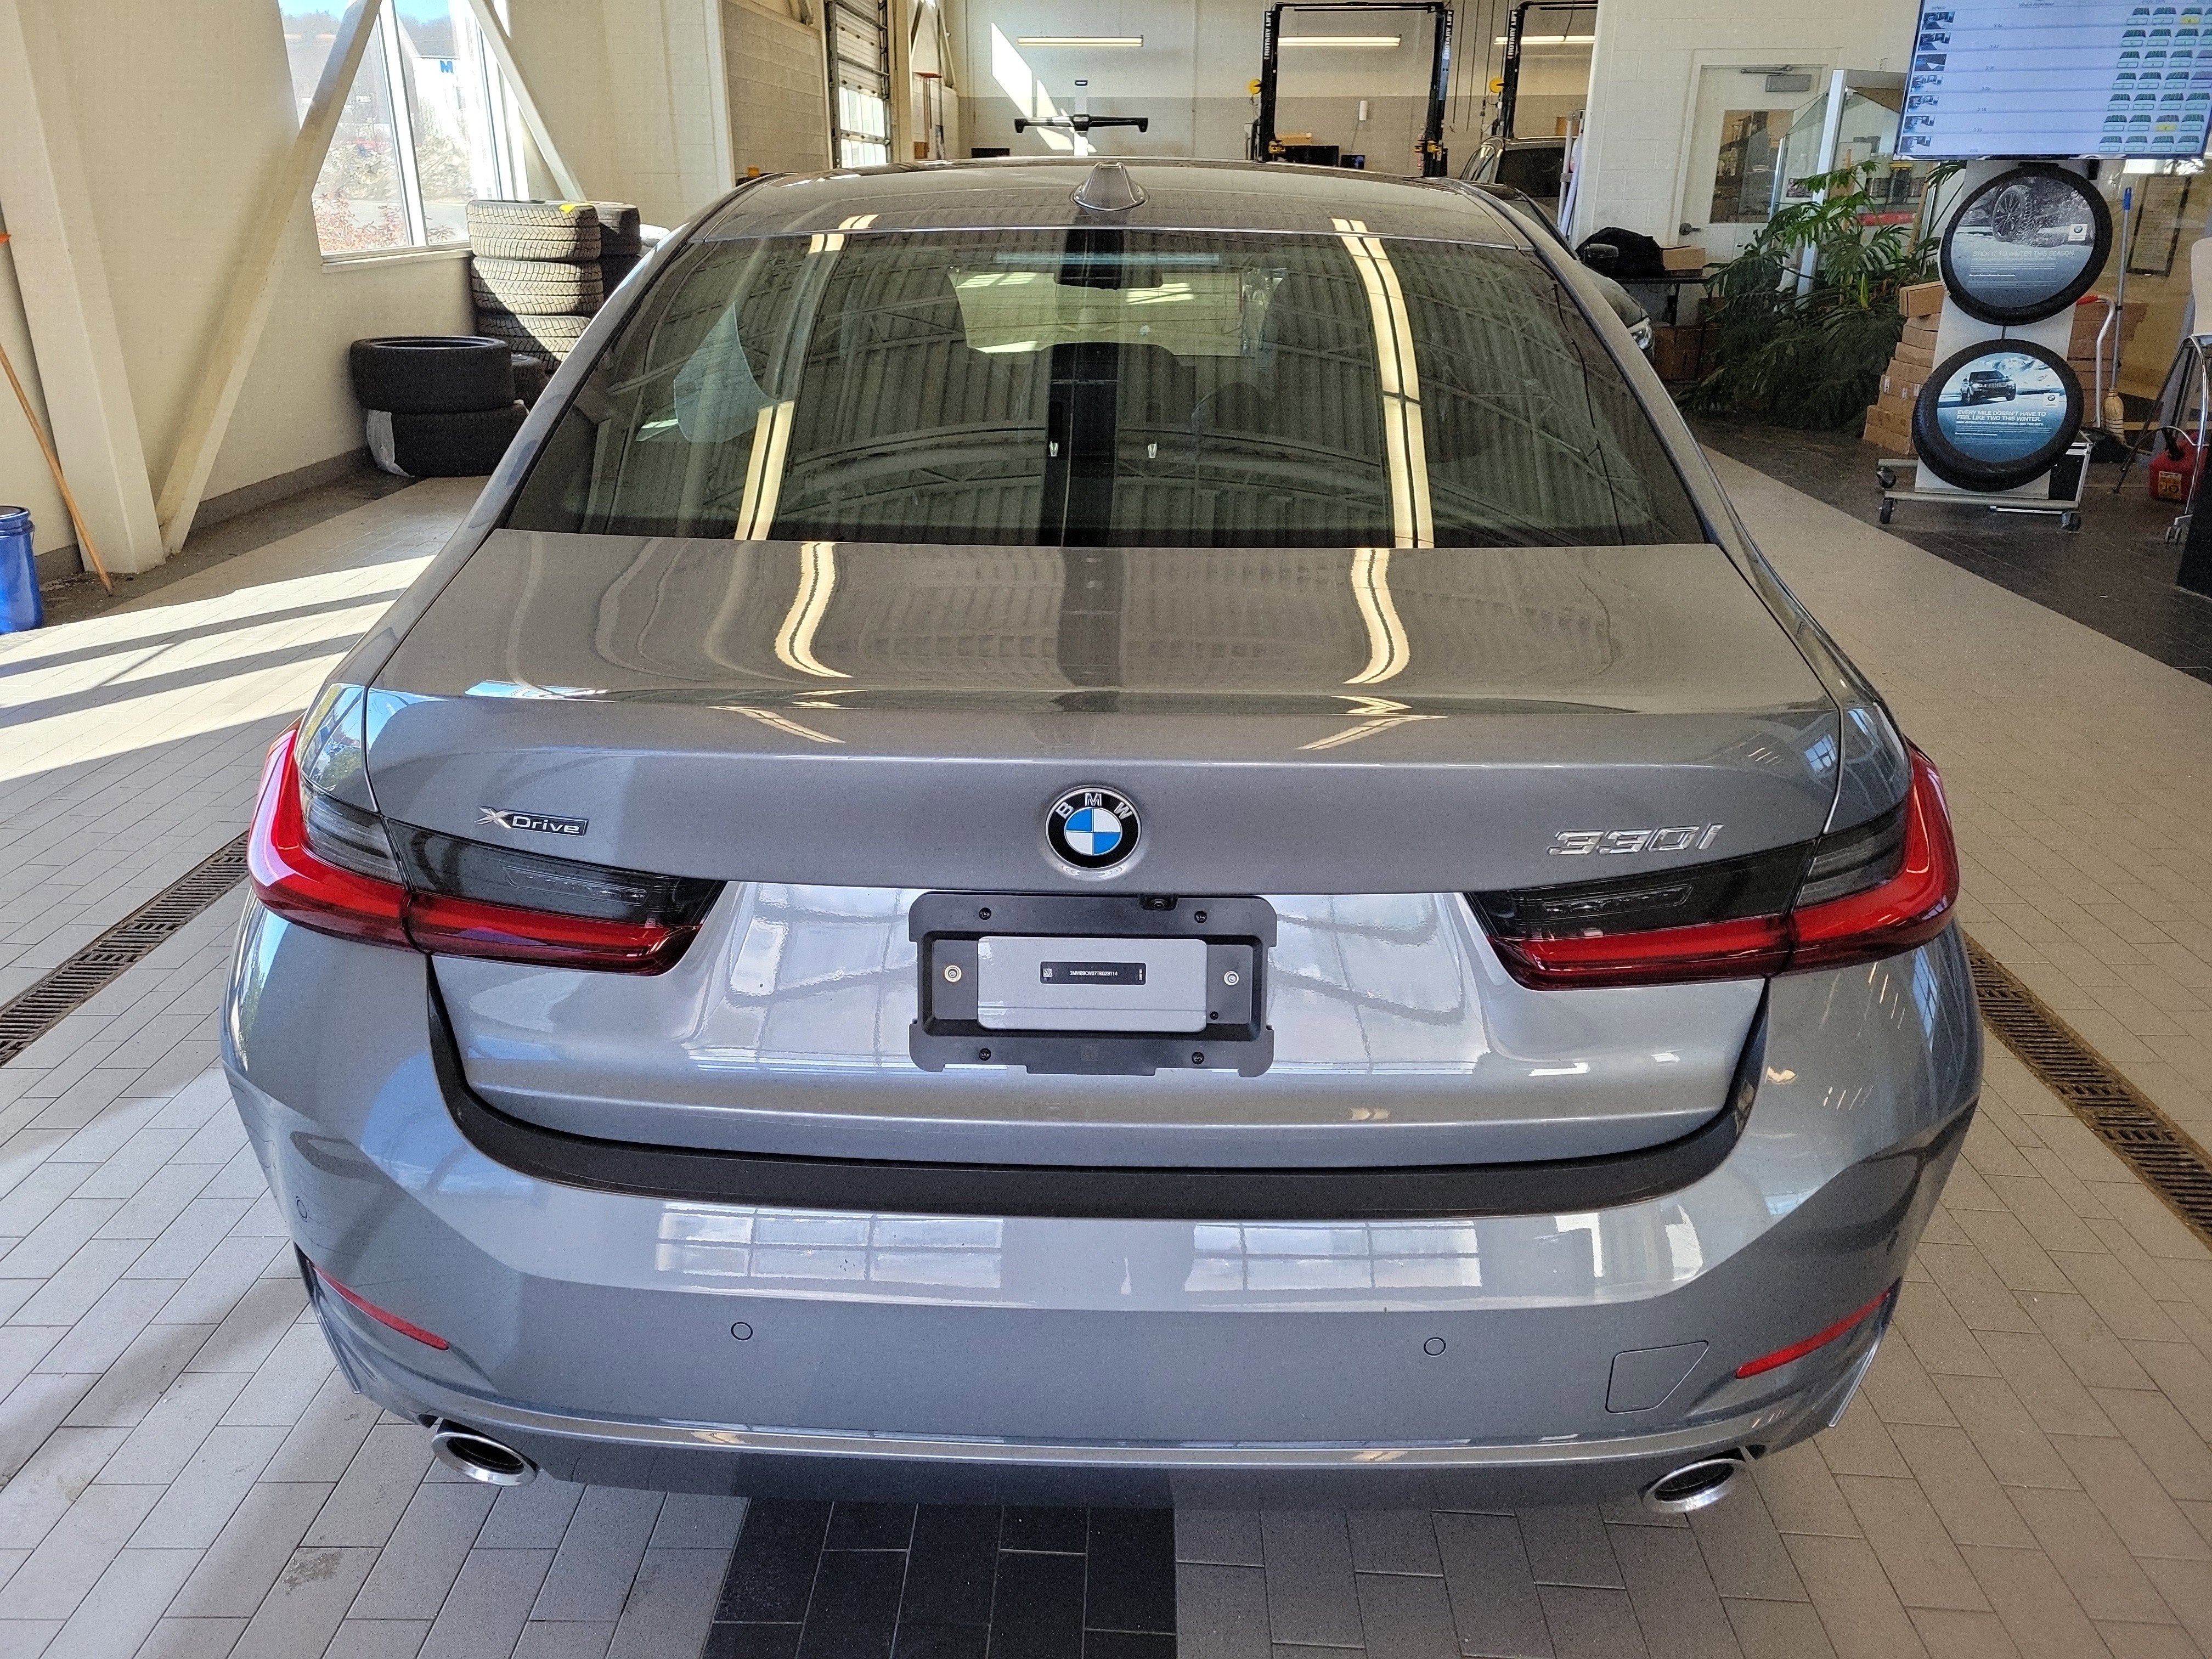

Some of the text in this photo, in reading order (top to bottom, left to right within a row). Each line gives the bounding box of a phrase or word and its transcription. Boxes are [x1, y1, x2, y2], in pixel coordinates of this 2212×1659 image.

[1508, 27, 1516, 55] ROTARY
[1055, 793, 1133, 820] BMW
[1547, 823, 1724, 855] 330i
